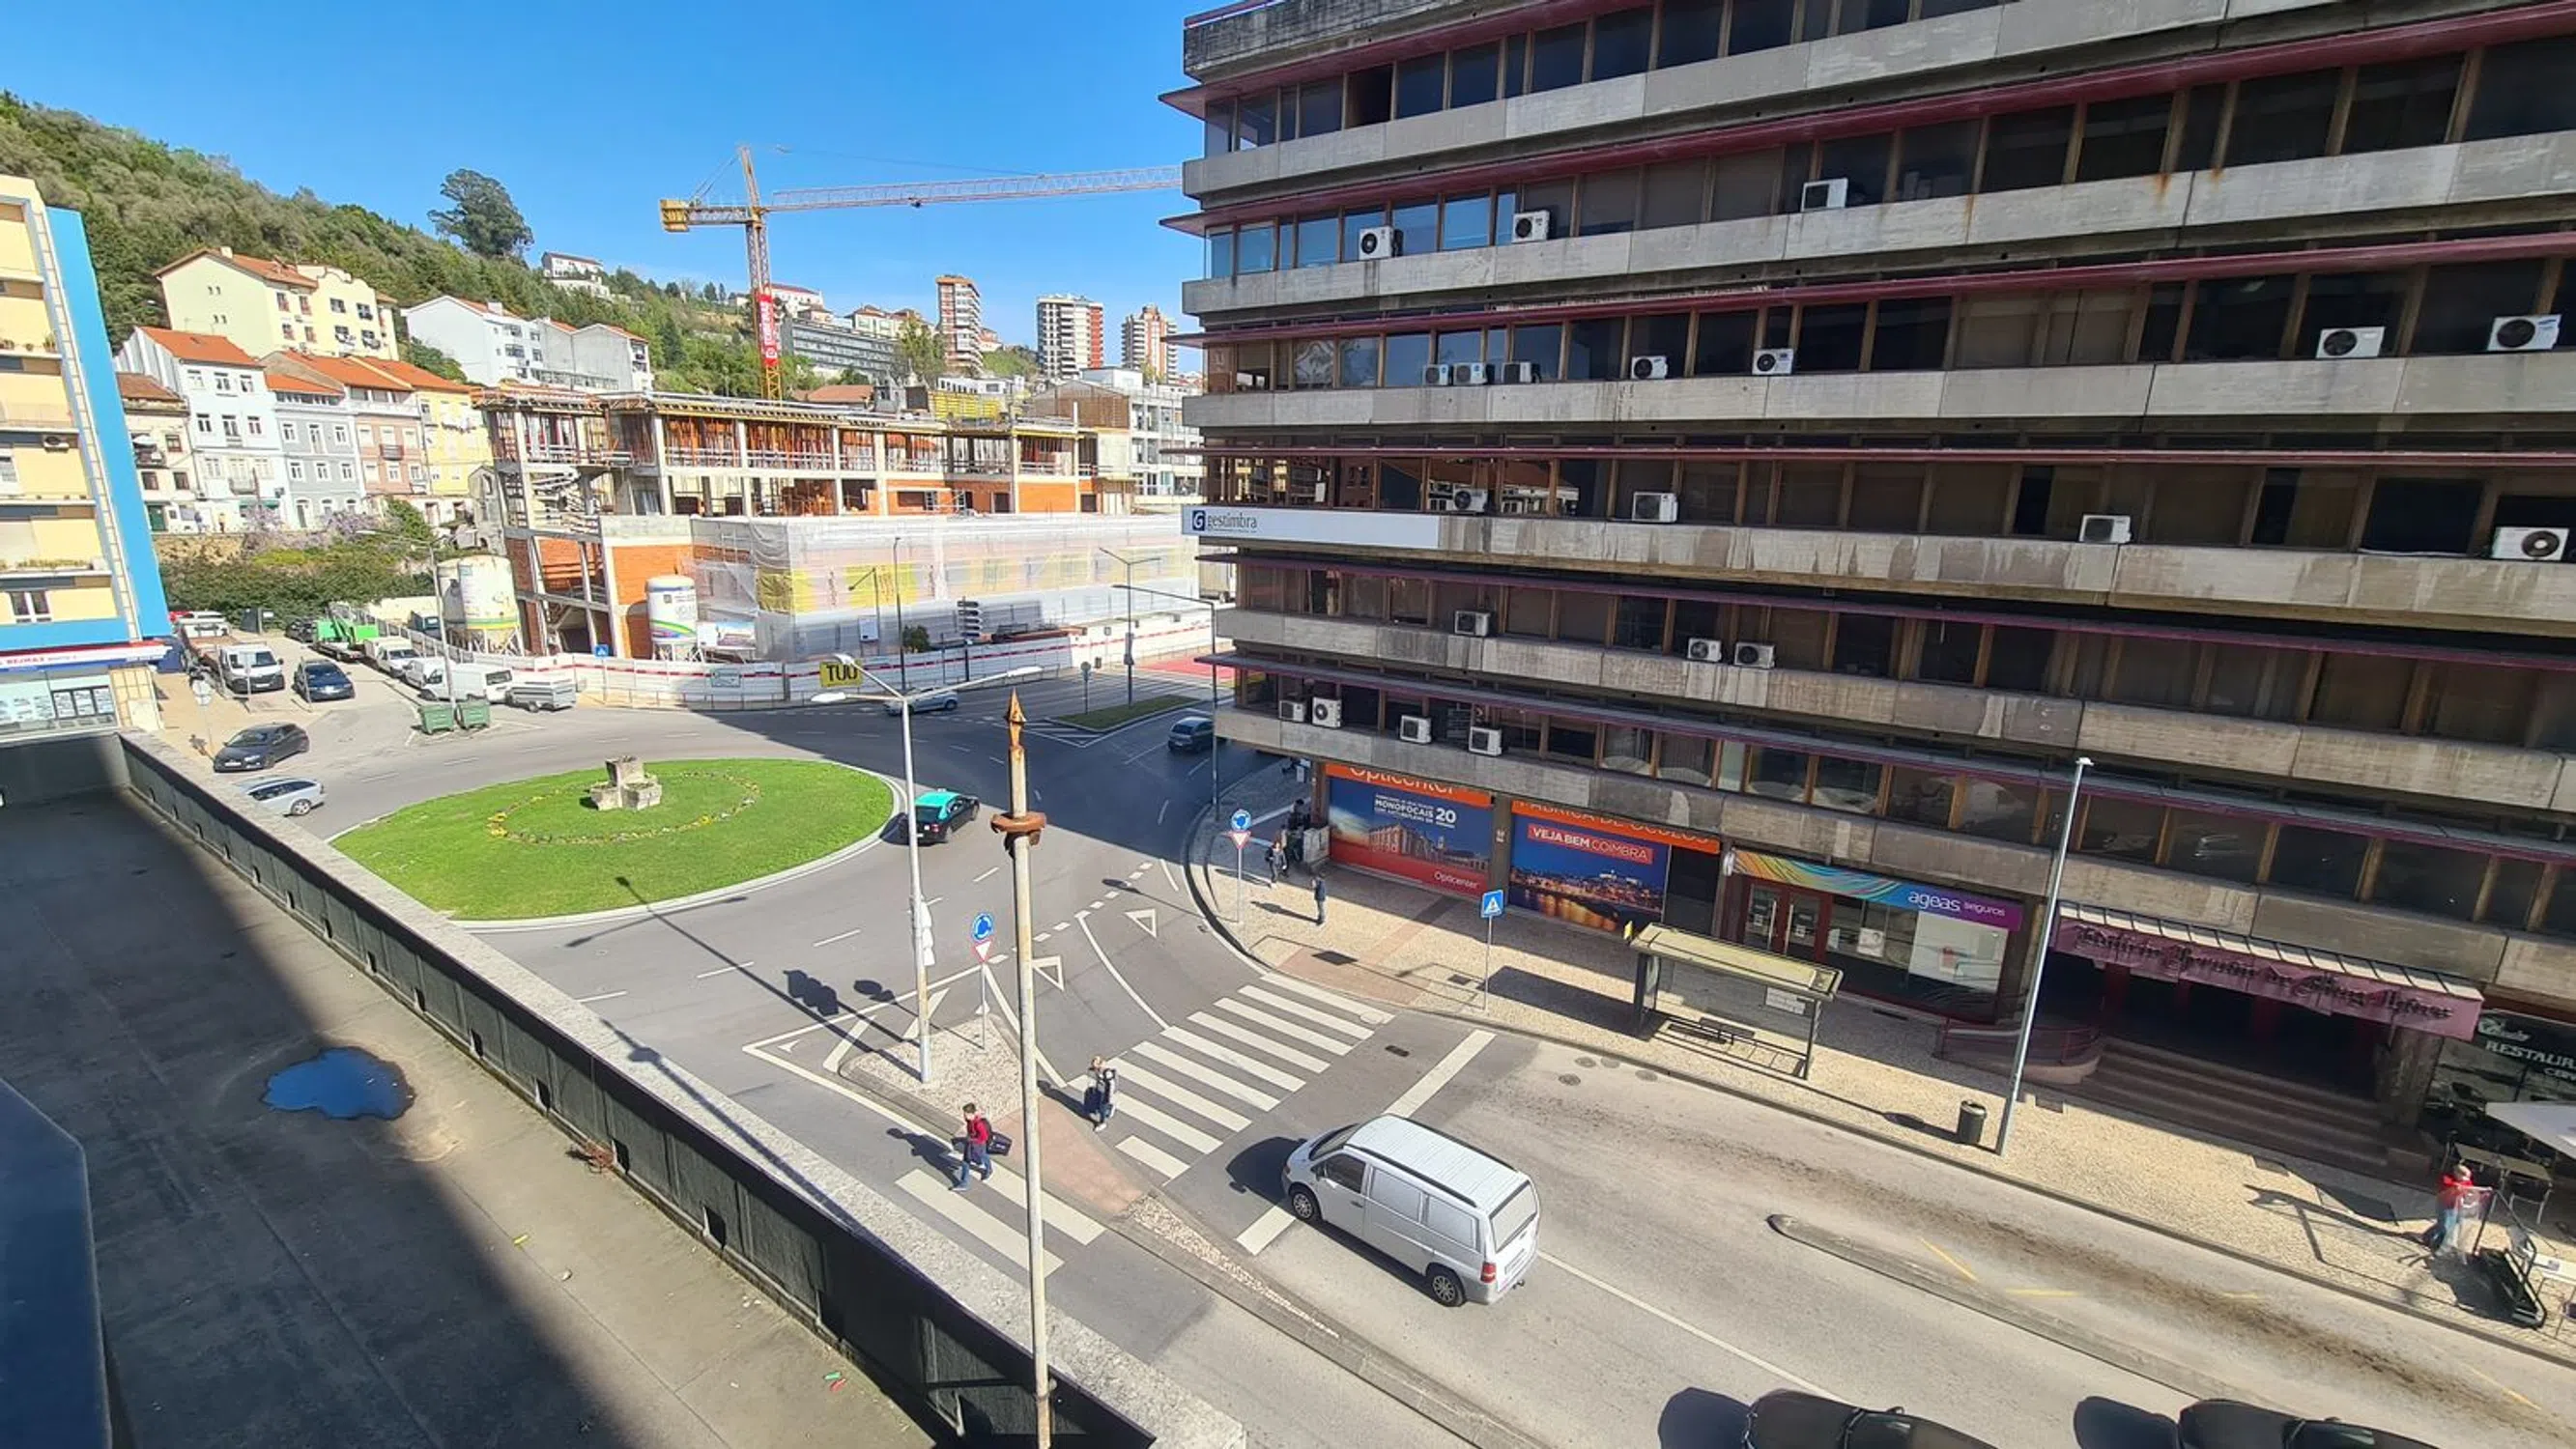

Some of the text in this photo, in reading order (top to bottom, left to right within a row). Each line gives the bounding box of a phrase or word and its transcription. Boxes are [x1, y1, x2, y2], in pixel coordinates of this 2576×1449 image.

[1374, 798, 1434, 818] MONOFOCAIS
[1436, 808, 1457, 824] 20
[1532, 827, 1647, 860] VEJA BEM COIMBRA
[1907, 891, 2006, 917] ageas seguros
